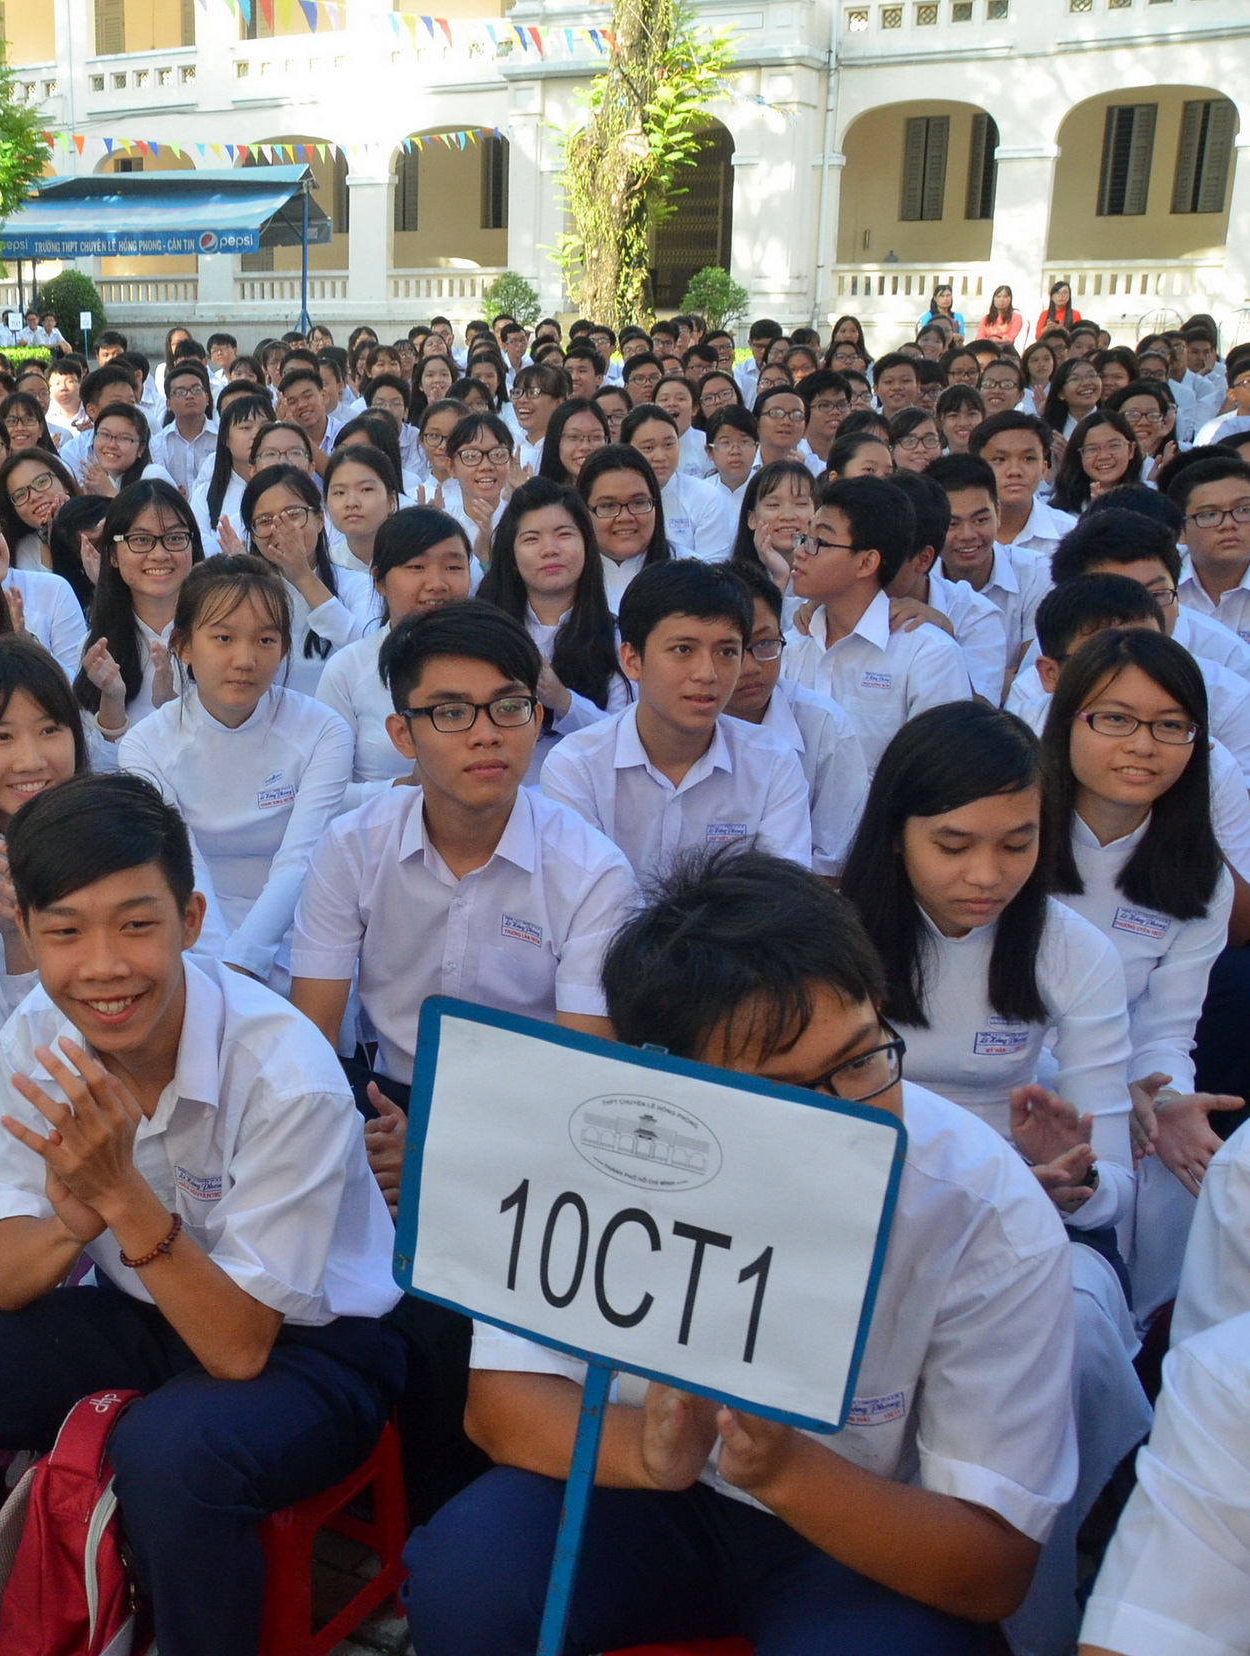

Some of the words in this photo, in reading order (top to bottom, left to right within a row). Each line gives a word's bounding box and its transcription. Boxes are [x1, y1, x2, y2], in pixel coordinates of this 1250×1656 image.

[62, 241, 78, 253] THPT
[80, 238, 106, 253] CHUYÊN
[139, 239, 161, 252] PHONG
[182, 239, 195, 250] TIN
[219, 234, 253, 249] pepsi
[619, 1099, 646, 1107] CHUYÊN
[676, 1112, 699, 1129] PHONG
[499, 1178, 774, 1364] 10CT1
